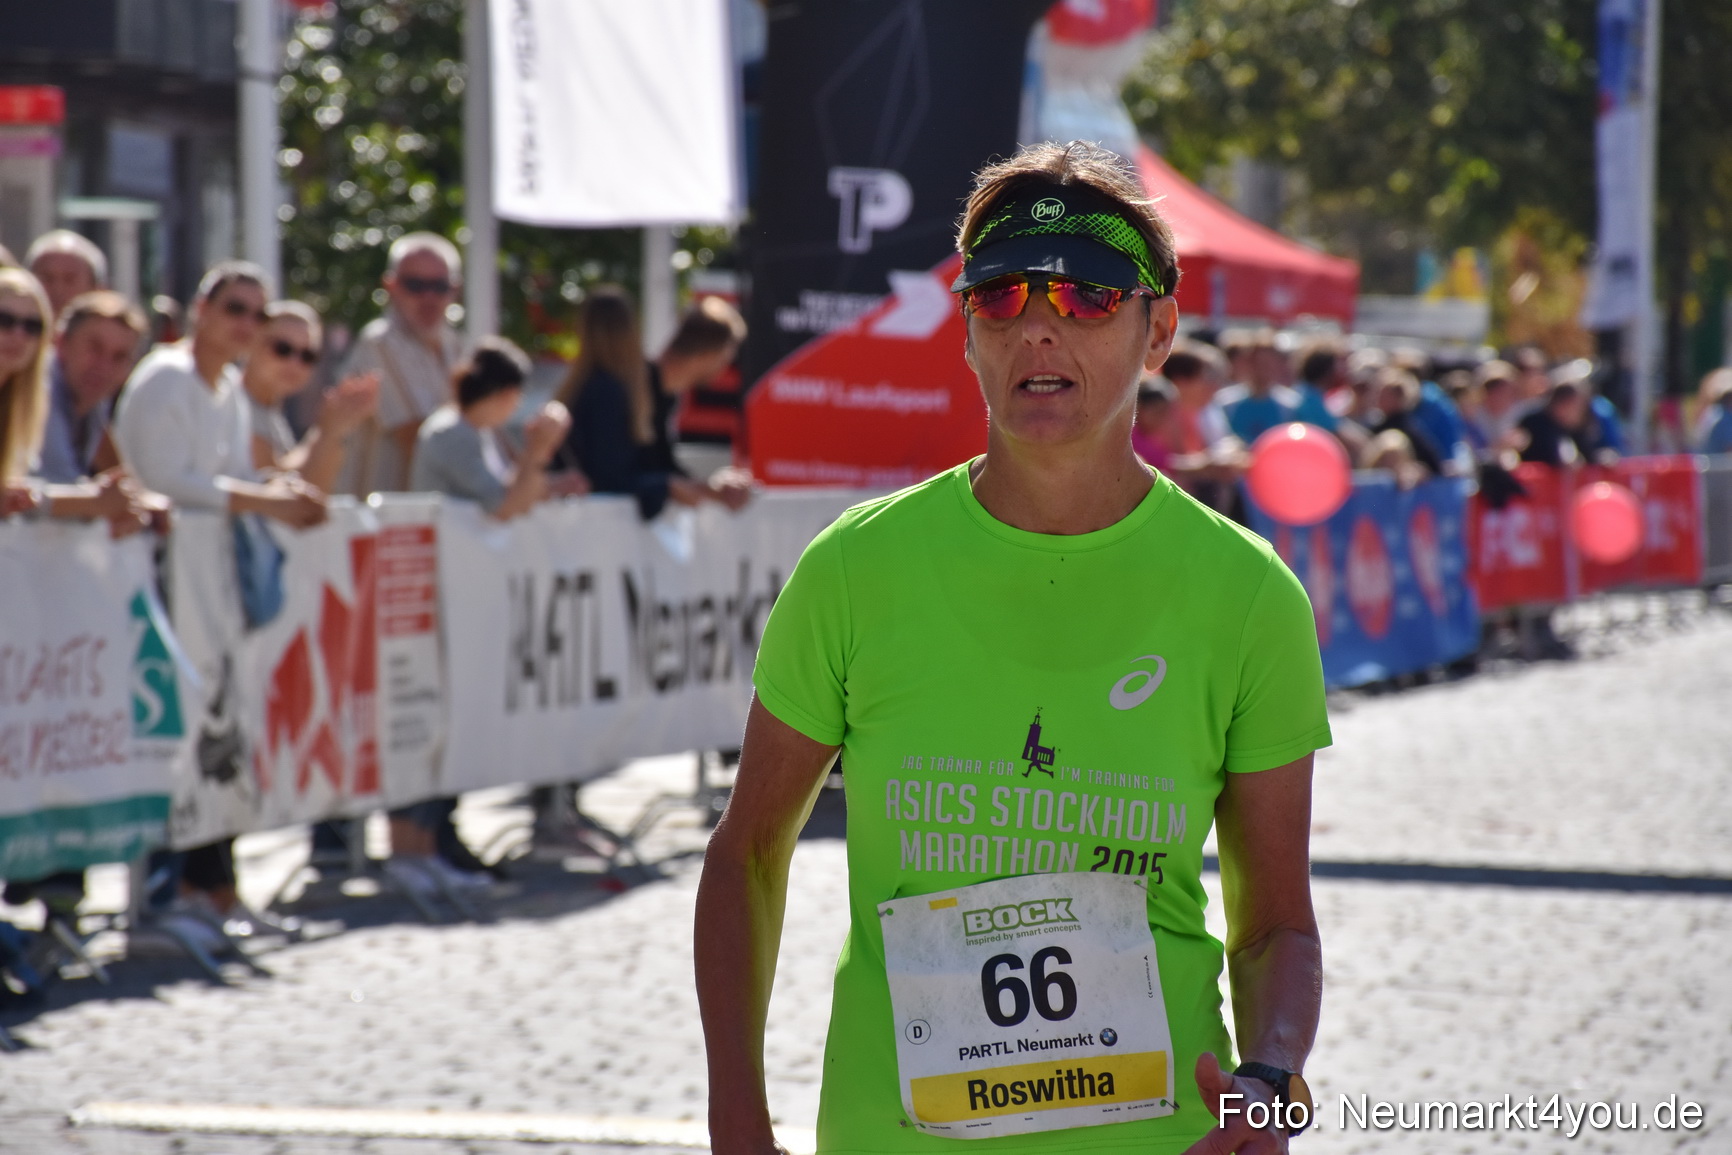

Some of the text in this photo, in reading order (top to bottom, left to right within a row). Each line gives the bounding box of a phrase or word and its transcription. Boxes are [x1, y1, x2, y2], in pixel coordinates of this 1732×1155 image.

[1036, 203, 1061, 217] Buff
[901, 755, 1014, 776] JAG TRÄNAR FÖR
[1088, 769, 1149, 790] TRAINING
[1155, 777, 1175, 792] FOR
[885, 779, 1187, 844] ASICS STOCKHOLM
[900, 829, 1167, 884] MARATHON 2015
[962, 898, 1079, 936] BOCK
[966, 923, 1082, 946] inspired by smart concepts
[981, 946, 1077, 1027] 66
[913, 1026, 923, 1039] D
[959, 1041, 1014, 1060] PARTL
[1017, 1033, 1094, 1053] Neumarkt
[967, 1068, 1115, 1111] Roswitha
